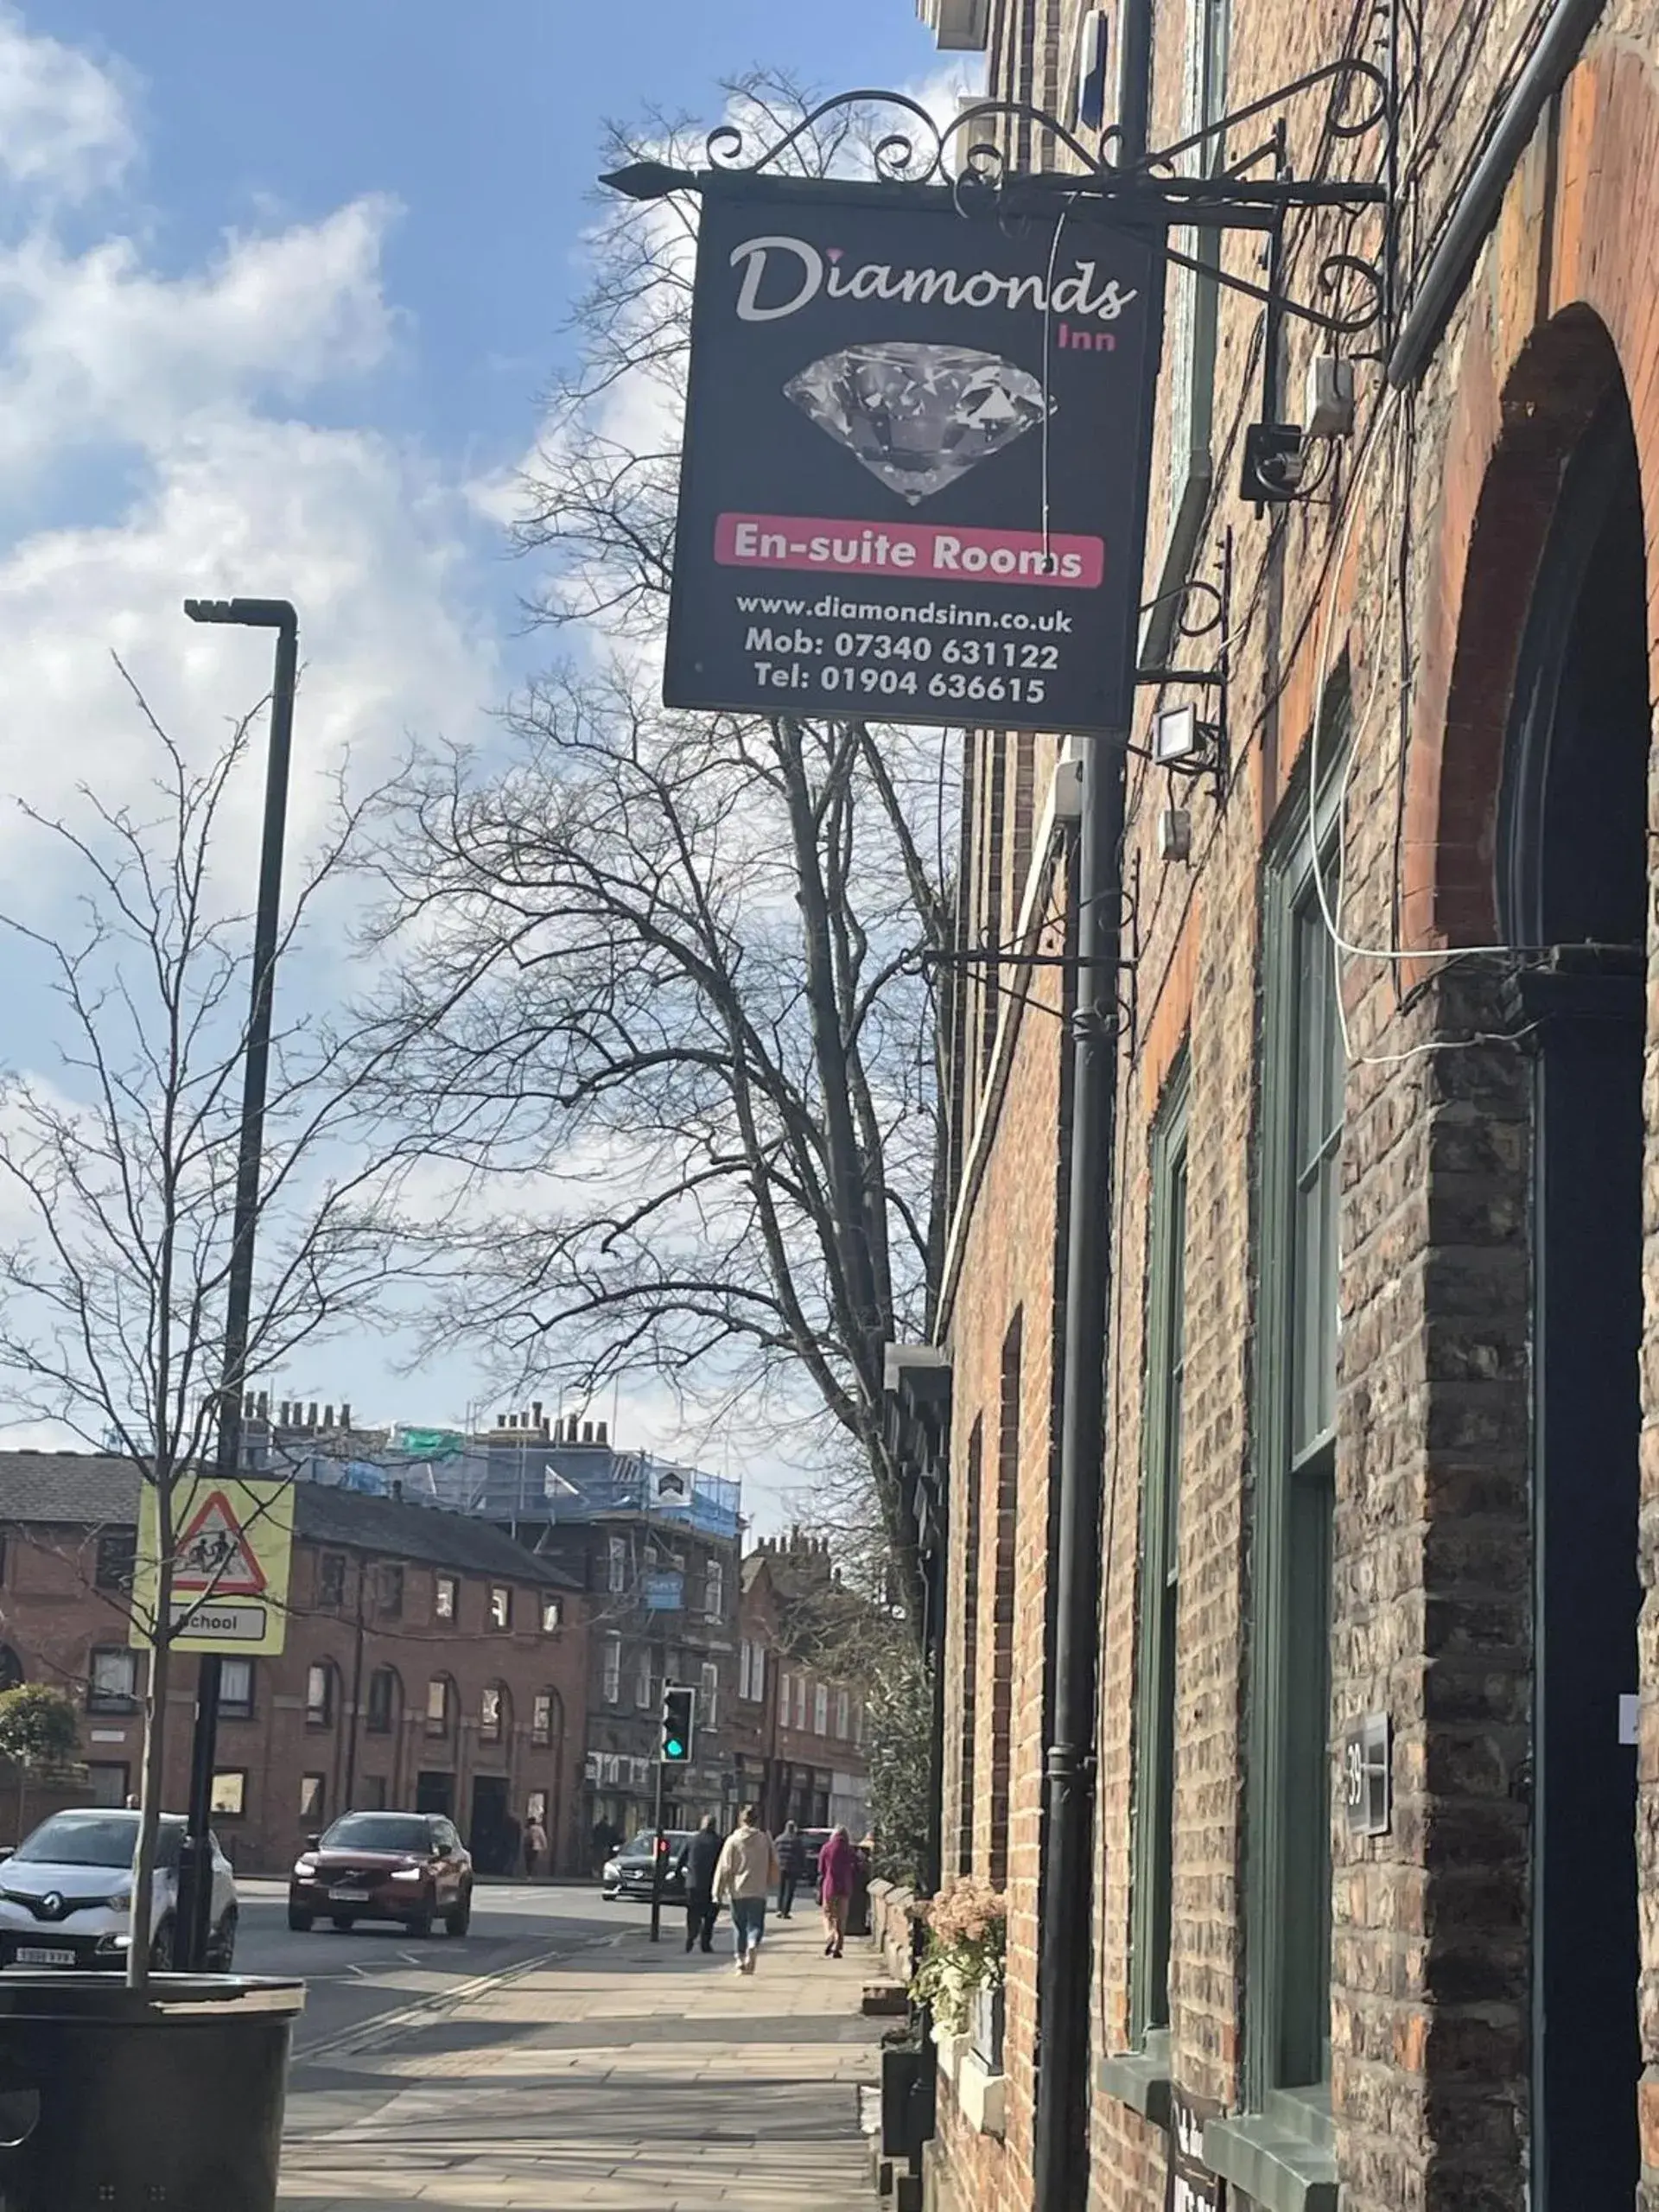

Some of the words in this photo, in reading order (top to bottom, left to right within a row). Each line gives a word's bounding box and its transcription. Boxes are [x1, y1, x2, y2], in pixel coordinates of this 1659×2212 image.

[730, 236, 1138, 321] Diamonds
[1058, 323, 1116, 351] Inn
[734, 523, 916, 567] En-suite
[933, 535, 1082, 578] Rooms
[736, 594, 1072, 632] www.diamondsinn.co.uk
[745, 626, 823, 655] Mob:
[835, 632, 931, 662] 07340
[942, 639, 1058, 670] 631122
[754, 662, 810, 689] Tel:
[821, 666, 918, 695] 01904
[928, 673, 1046, 703] 636615
